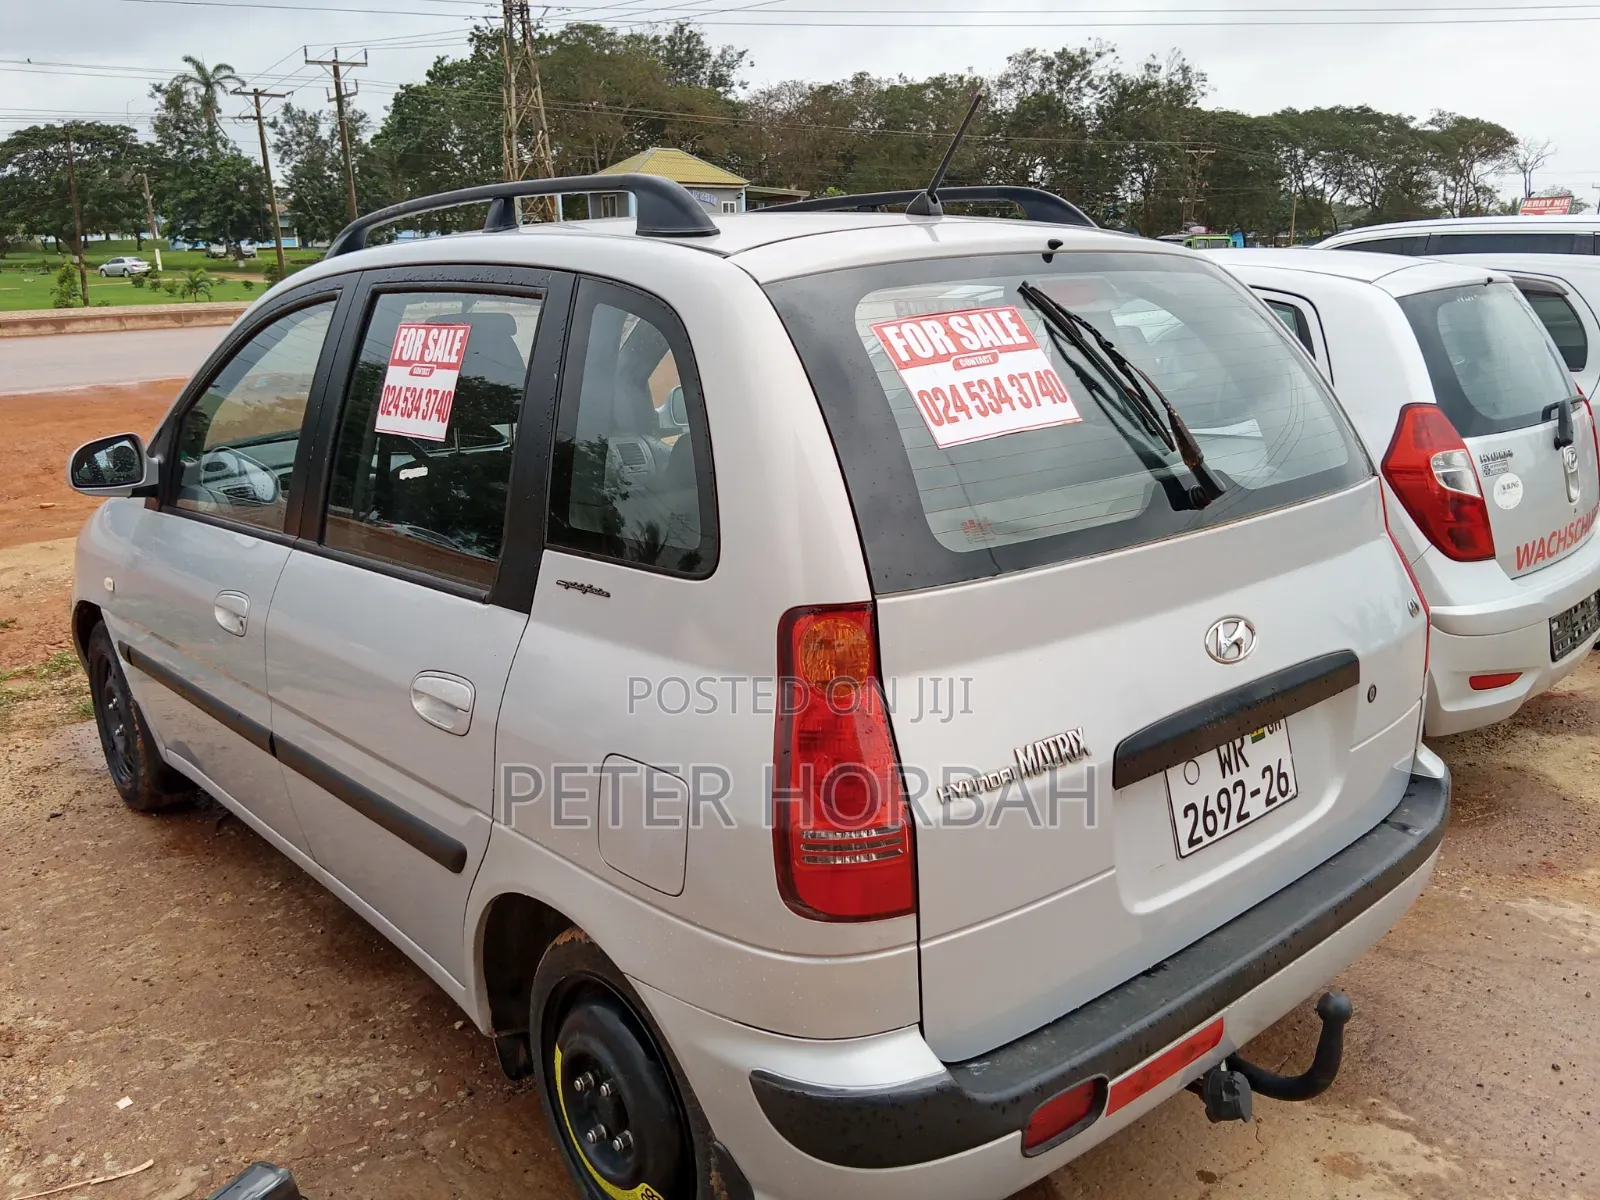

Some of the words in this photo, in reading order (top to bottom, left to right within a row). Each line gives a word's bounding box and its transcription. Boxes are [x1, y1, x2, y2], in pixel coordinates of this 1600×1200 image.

[1522, 199, 1553, 208] JERRY
[394, 328, 427, 361] FOR
[423, 328, 465, 363] SALE
[881, 319, 958, 362] FOR
[947, 310, 1029, 352] SALE
[959, 354, 993, 368] CONTACT
[380, 384, 403, 417] 024
[400, 386, 424, 420] 534
[421, 388, 453, 424] 3740
[917, 384, 972, 427] 024
[963, 376, 1017, 418] 534
[1007, 369, 1068, 410] 3740
[936, 765, 1015, 805] HYUNDAI
[1013, 726, 1092, 781] MATRIX
[1216, 735, 1250, 779] WR
[1183, 758, 1290, 849] 2692-26
